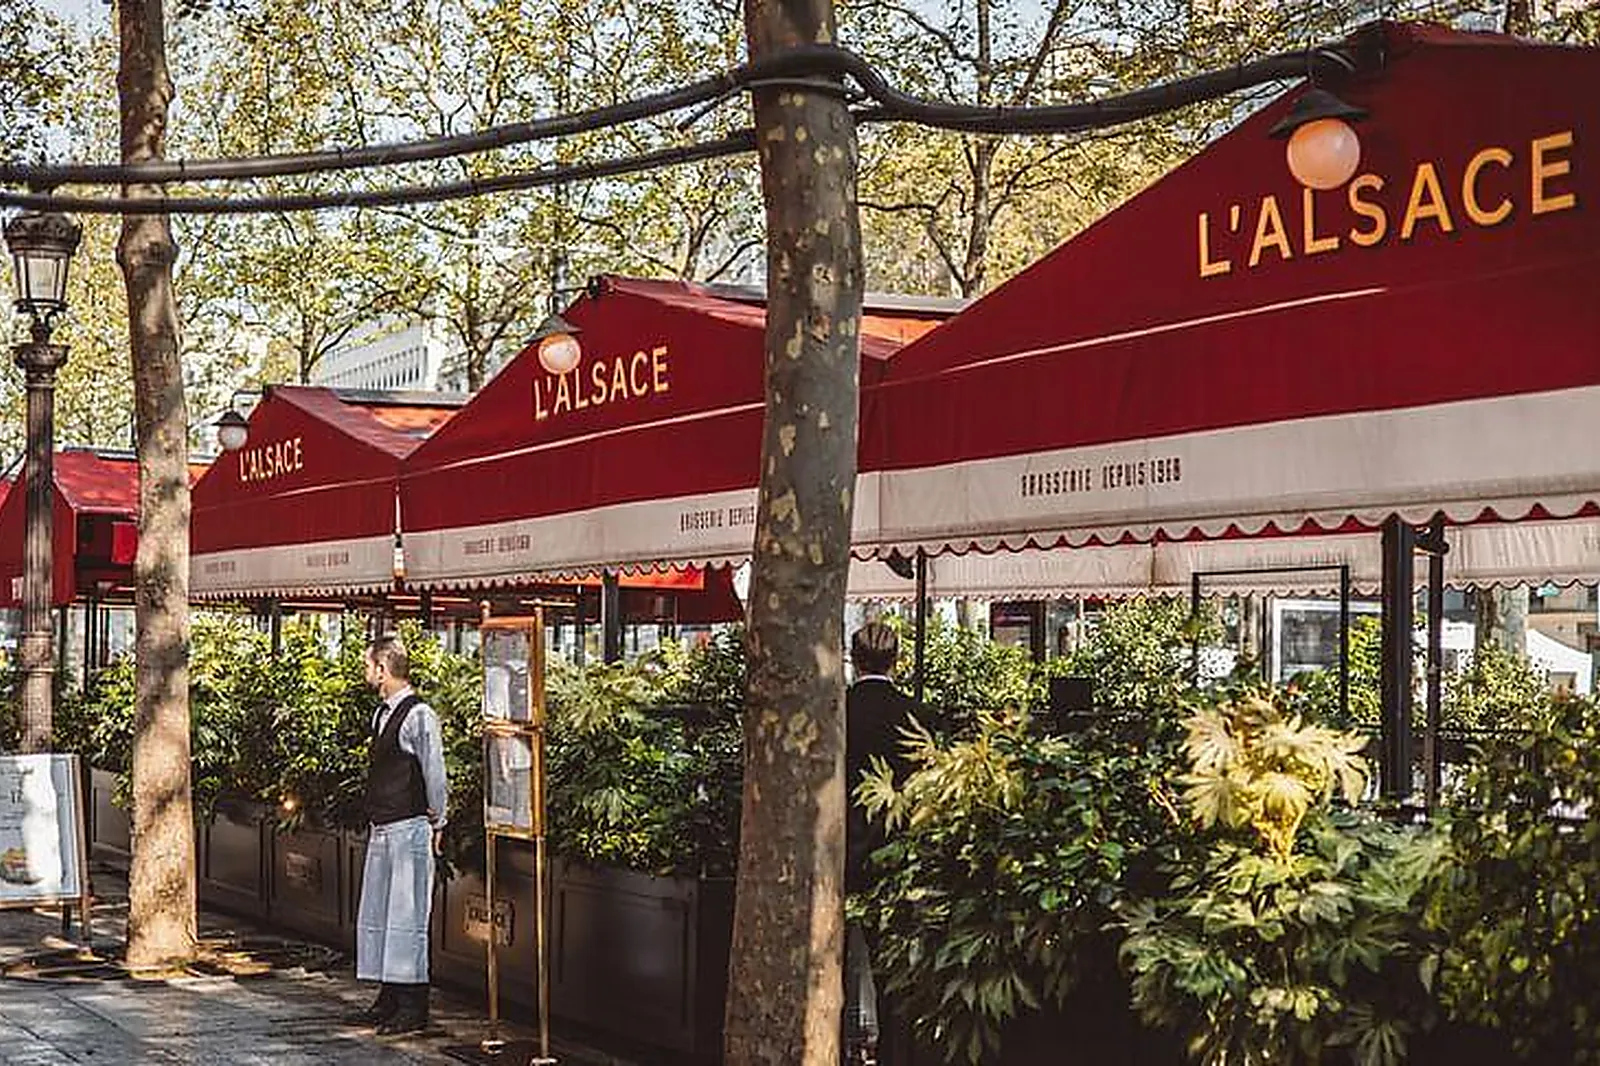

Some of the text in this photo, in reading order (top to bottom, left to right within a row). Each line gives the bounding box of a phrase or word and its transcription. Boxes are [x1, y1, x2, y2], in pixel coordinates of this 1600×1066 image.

[1199, 131, 1577, 278] L'ALSACE
[534, 346, 670, 421] L'ALSACE
[239, 438, 304, 482] L'ALSACE
[1021, 469, 1092, 497] BRASSERIE
[1102, 462, 1146, 490] DEPUIS
